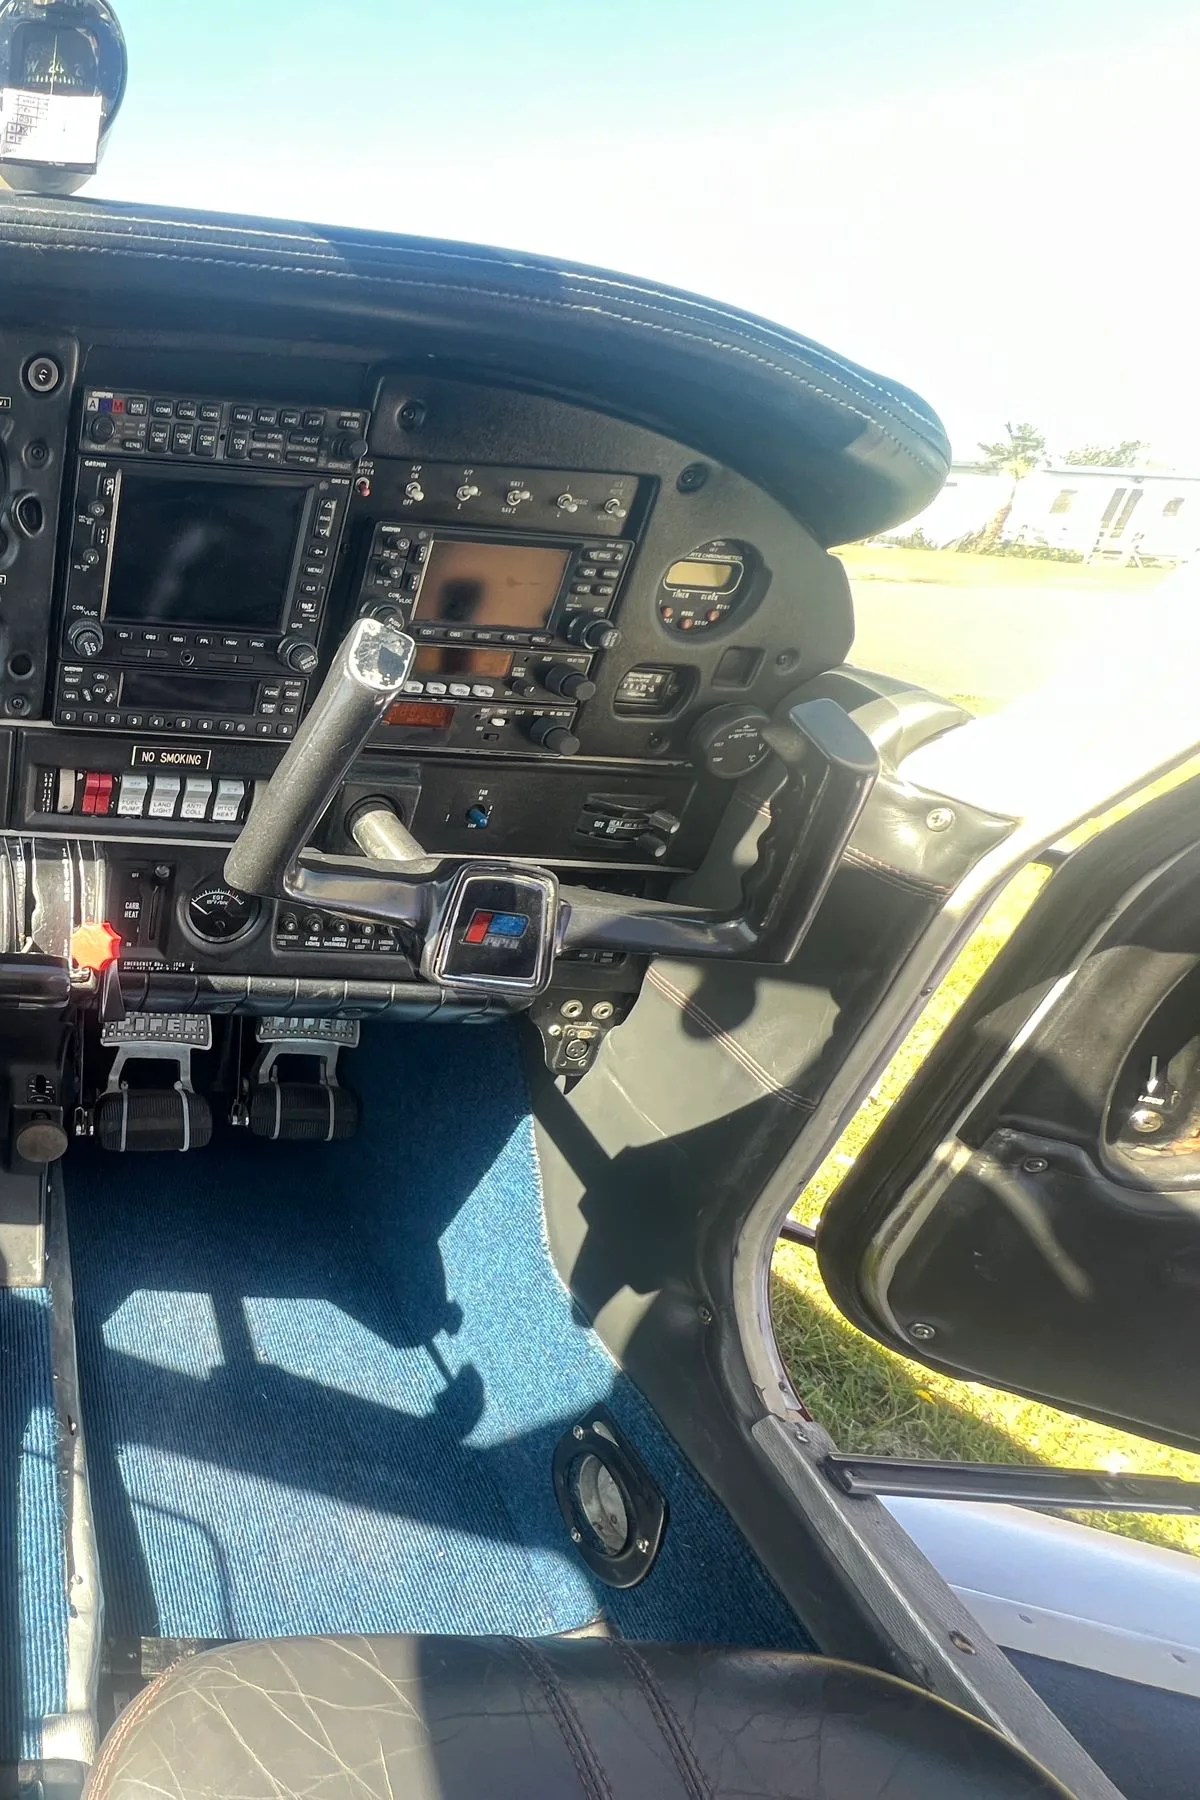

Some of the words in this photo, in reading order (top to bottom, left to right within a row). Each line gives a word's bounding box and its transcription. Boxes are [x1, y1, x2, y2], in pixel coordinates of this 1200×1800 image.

[48, 61, 64, 73] 24
[89, 400, 97, 409] A
[113, 401, 122, 411] M
[141, 751, 155, 762] NO
[160, 752, 201, 765] SMOKING
[594, 820, 605, 828] OFF
[609, 820, 623, 828] HEAT
[125, 901, 140, 910] CARB.
[483, 938, 519, 949] PIPER
[117, 1017, 197, 1032] PIPER
[273, 1016, 348, 1031] PIPER
